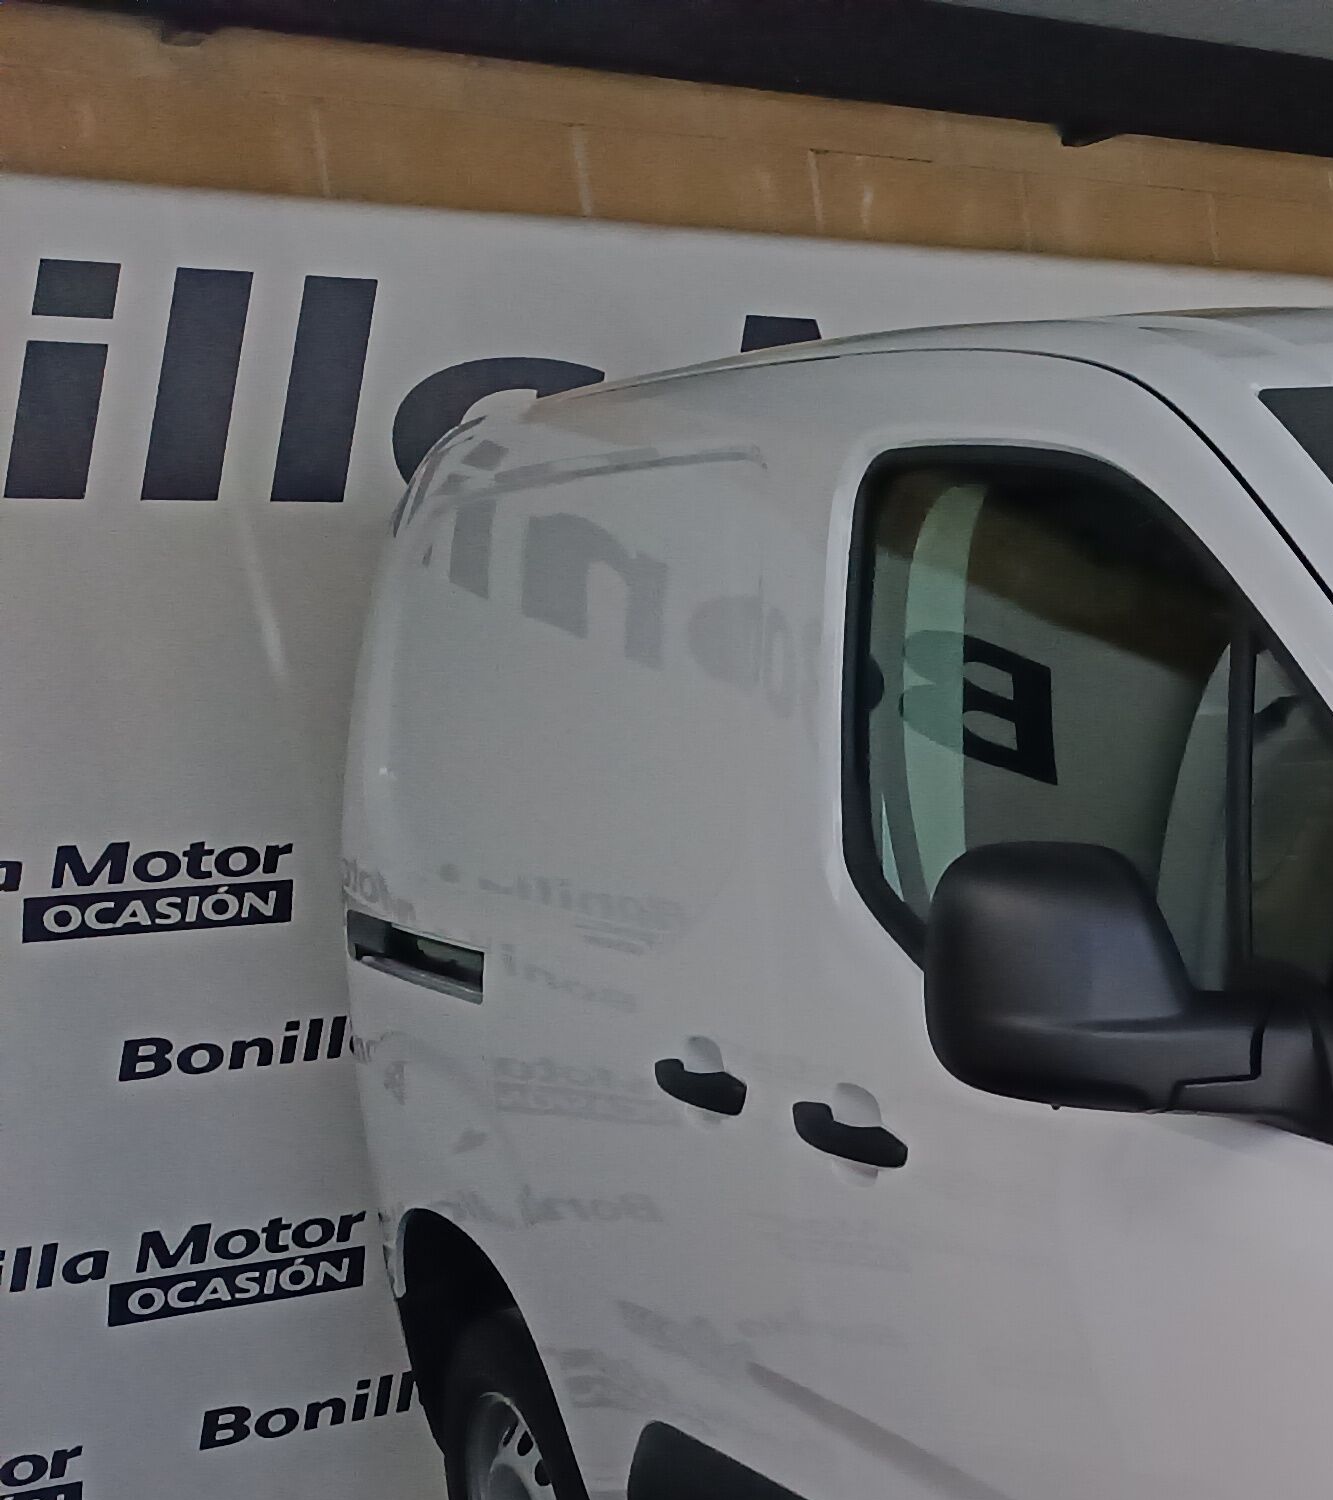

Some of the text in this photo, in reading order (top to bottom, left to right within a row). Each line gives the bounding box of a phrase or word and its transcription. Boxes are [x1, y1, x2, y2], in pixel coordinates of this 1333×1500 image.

[51, 841, 293, 889] Motor
[43, 886, 276, 933] OCASIÓN
[118, 1015, 355, 1082] Bonill
[136, 1210, 366, 1273] Motor
[127, 1257, 349, 1315] OCASIÓN
